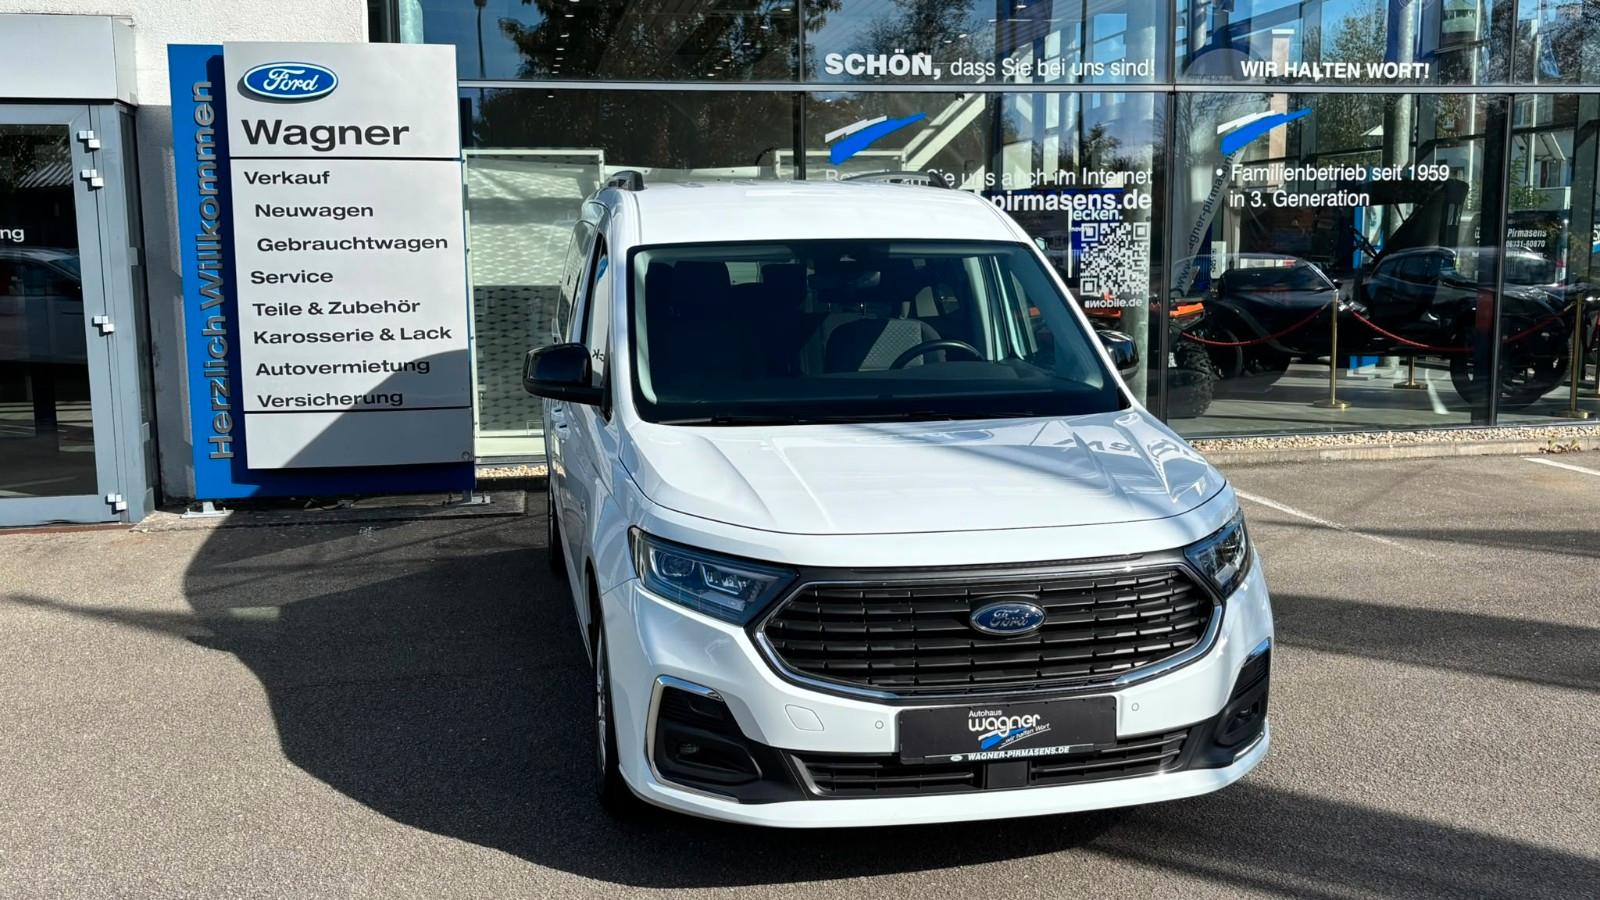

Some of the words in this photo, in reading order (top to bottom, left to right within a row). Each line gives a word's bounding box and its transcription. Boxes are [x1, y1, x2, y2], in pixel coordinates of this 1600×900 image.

[824, 48, 941, 80] SCHÖN,
[950, 57, 996, 76] dass
[1001, 57, 1032, 76] Sie
[1037, 58, 1066, 76] bei
[1072, 63, 1109, 76] uns
[1110, 58, 1155, 76] sind!
[1240, 61, 1279, 77] WIR
[1284, 62, 1365, 79] HALTEN
[1366, 63, 1430, 79] WORT!
[263, 67, 319, 92] Ford
[240, 119, 410, 151] Wagner
[243, 170, 330, 185] Verkauf
[1054, 169, 1076, 186] im
[1083, 167, 1153, 186] Internet
[1231, 164, 1367, 181] Familienbetrieb
[1371, 164, 1402, 181] seit
[1408, 164, 1450, 182] 1959
[192, 81, 225, 311] Willkommen
[1229, 191, 1245, 207] in
[1250, 191, 1267, 207] 3.
[1273, 190, 1370, 207] Generation
[255, 204, 374, 220] Neuwagen
[1507, 227, 1547, 238] Pirmasens
[256, 236, 448, 252] Gebrauchtwagen
[250, 270, 333, 284] Service
[252, 303, 303, 317] Teile
[307, 301, 324, 315] &
[328, 299, 421, 315] Zubehör
[253, 329, 374, 344] Karosserie
[379, 327, 394, 341] &
[400, 326, 453, 341] Lack
[256, 358, 431, 377] Autovermietung
[201, 316, 234, 460] Herzlich
[256, 391, 404, 407] Versicherung
[968, 709, 1002, 718] Autohaus
[968, 714, 1041, 738] wagner
[968, 745, 1071, 761] WAGNER-PIRMASENS.DE
